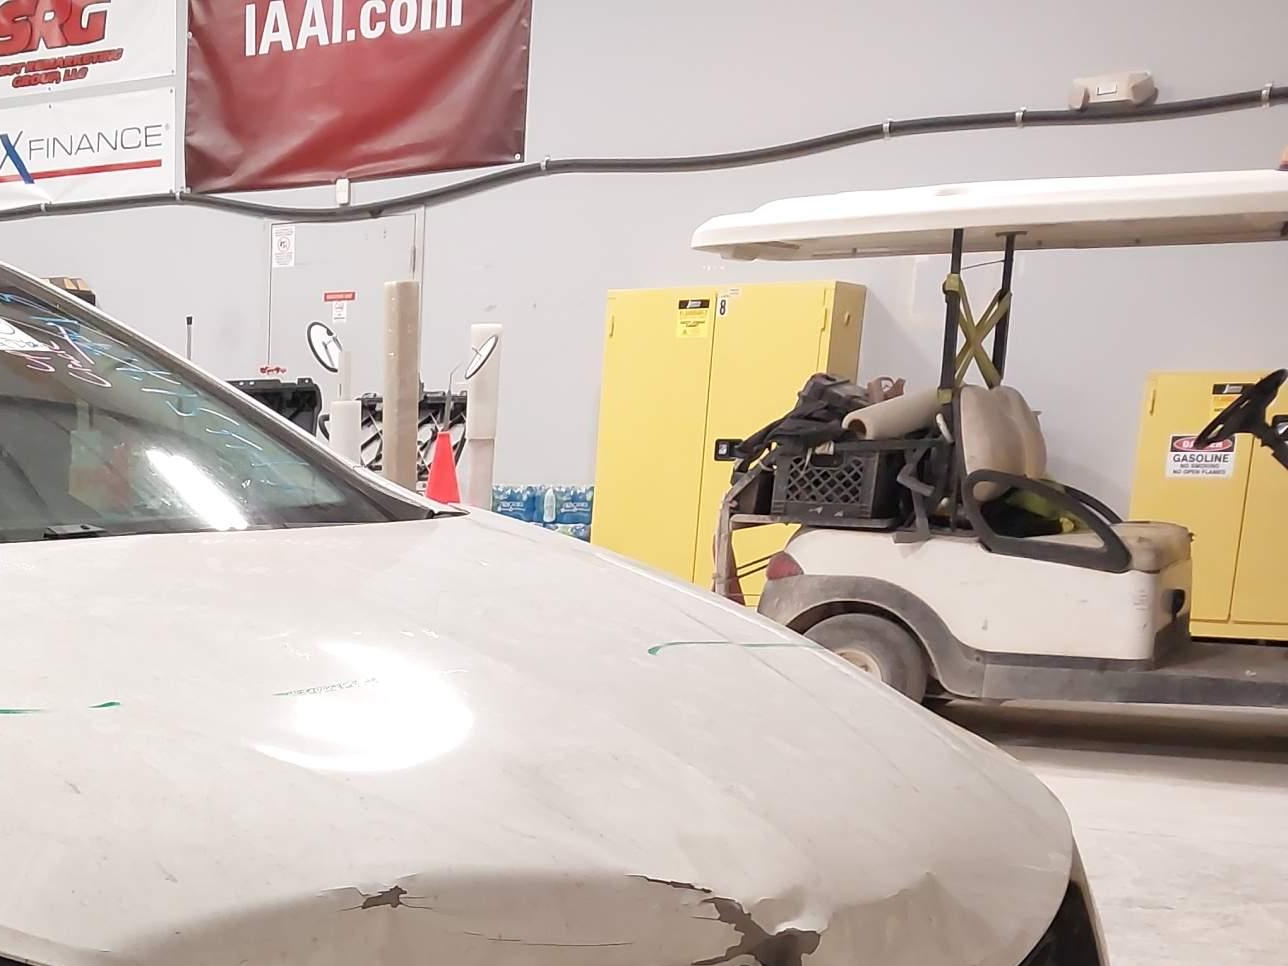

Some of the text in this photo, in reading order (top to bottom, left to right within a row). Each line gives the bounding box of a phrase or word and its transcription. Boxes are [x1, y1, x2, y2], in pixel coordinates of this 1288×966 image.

[245, 0, 462, 57] IAAI.com
[719, 298, 727, 315] 8
[1173, 454, 1229, 462] GASOLINE
